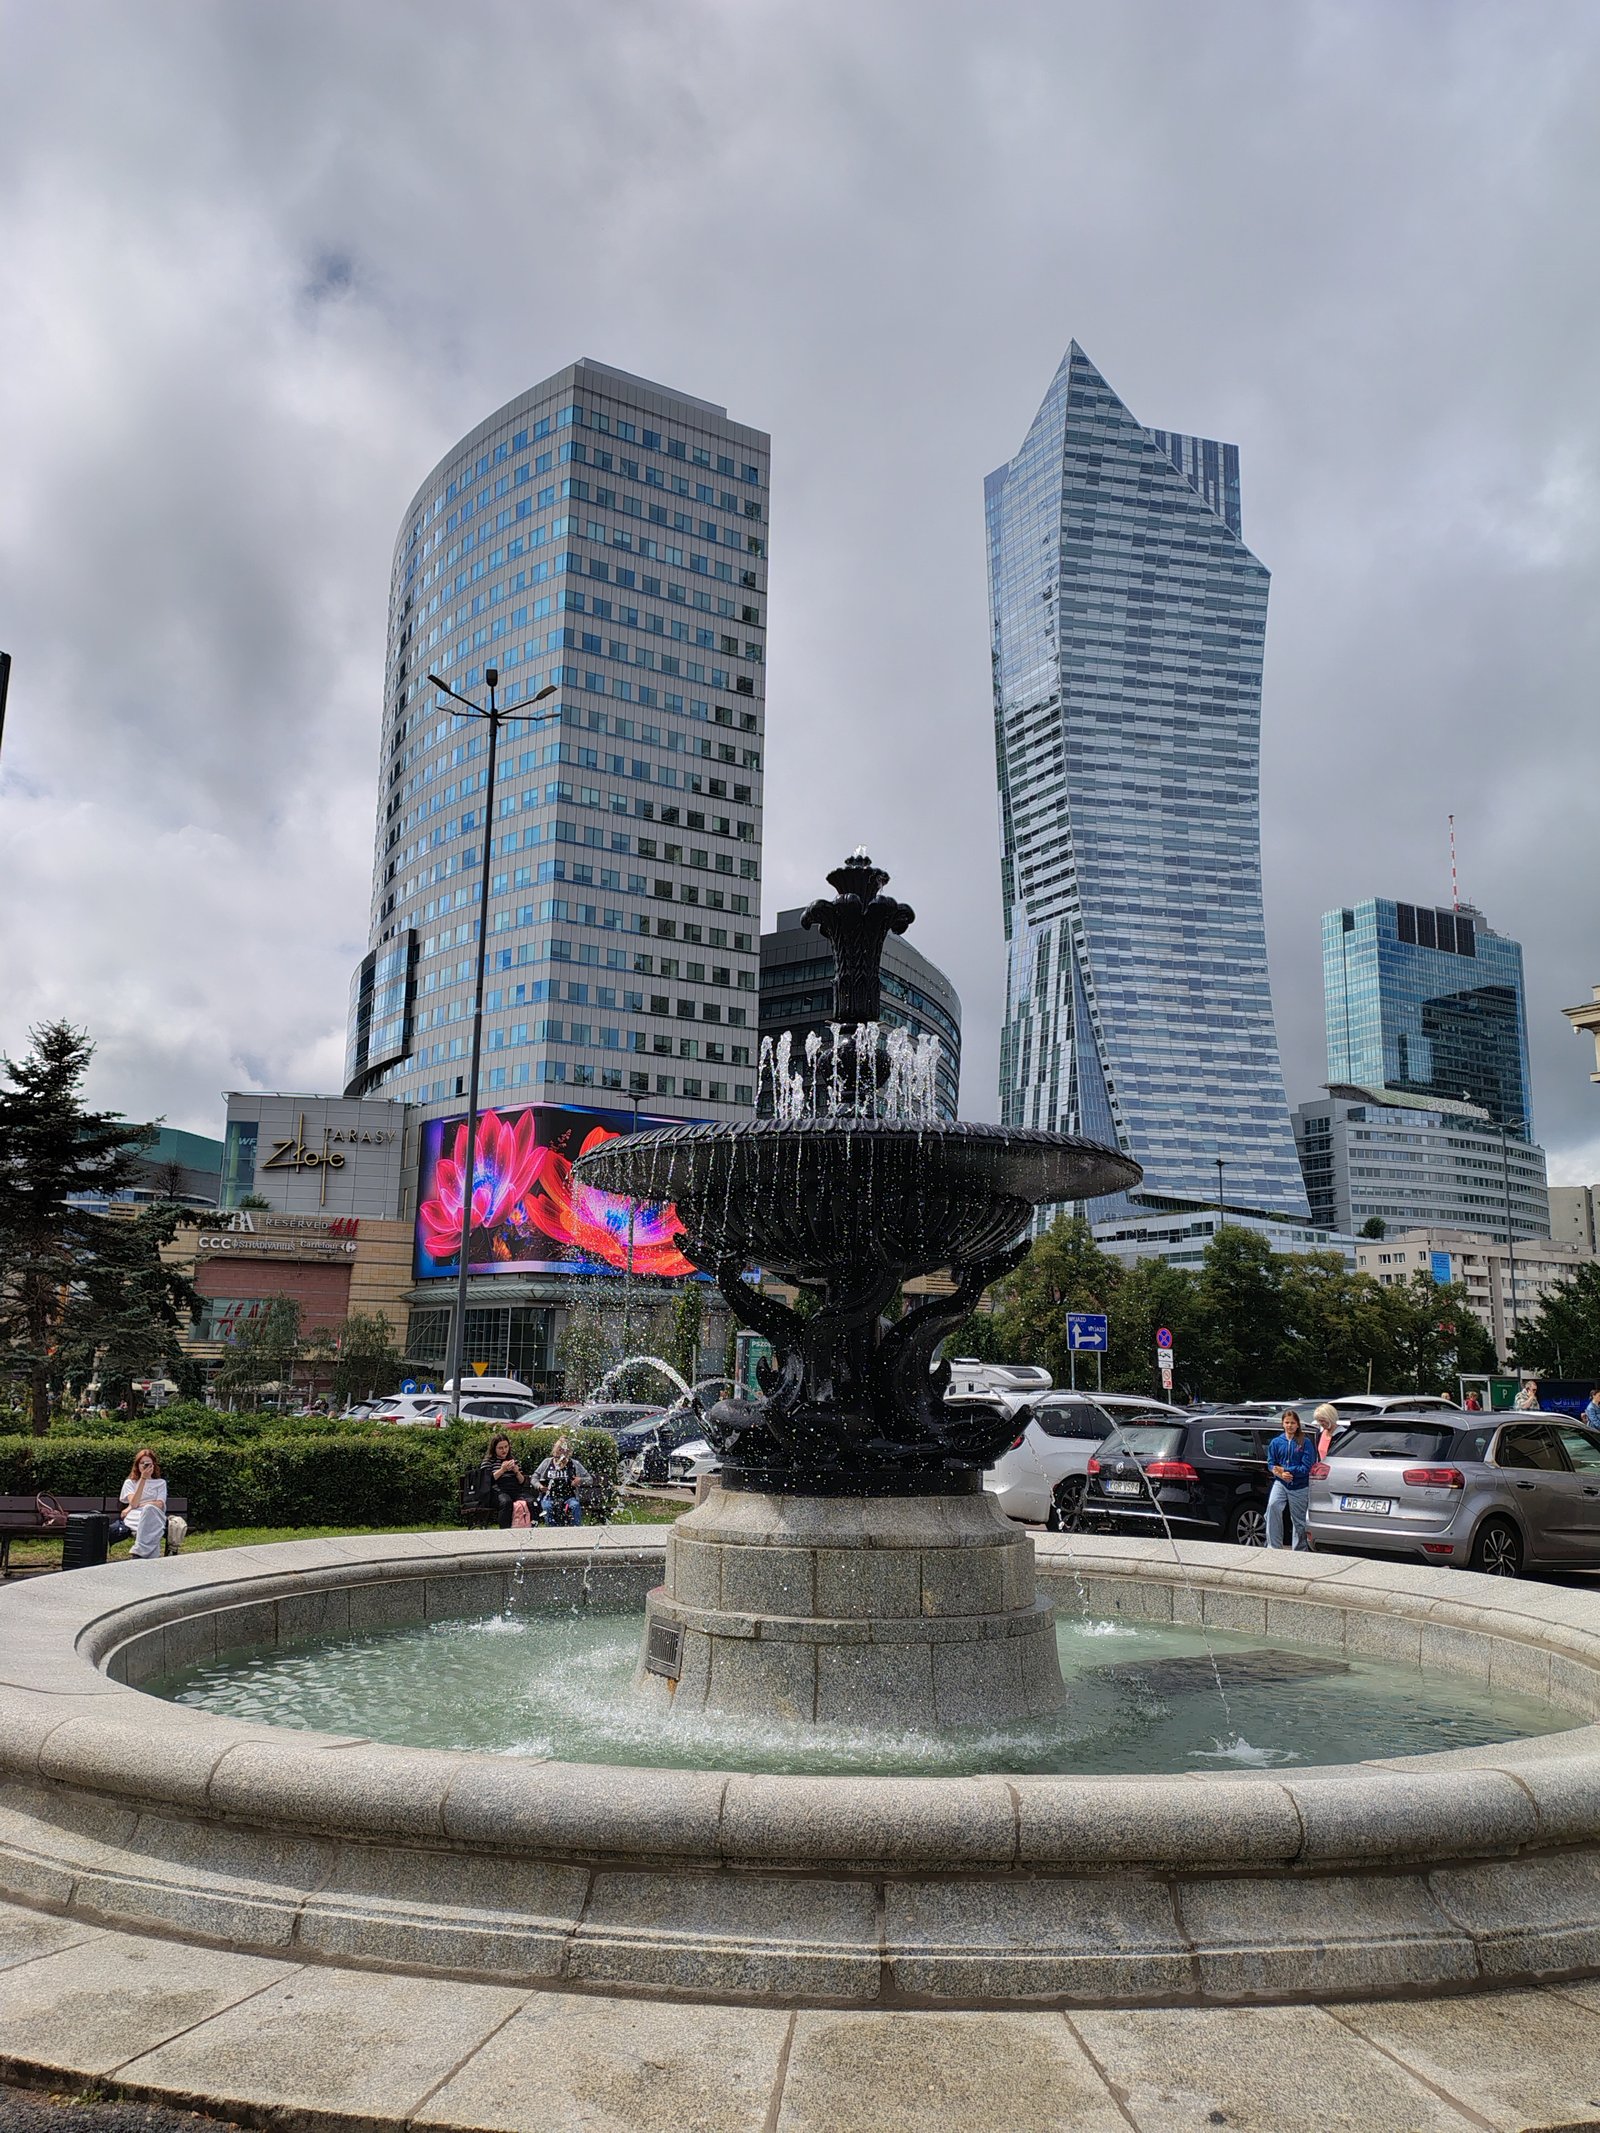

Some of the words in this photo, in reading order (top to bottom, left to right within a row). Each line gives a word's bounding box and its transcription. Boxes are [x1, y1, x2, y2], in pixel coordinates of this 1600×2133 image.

[323, 1127, 397, 1144] TARASY
[265, 1216, 329, 1230] RESERVED
[198, 1236, 232, 1249] CCC
[239, 1240, 296, 1251] STRADIVARIUS
[300, 1240, 339, 1250] Carrefour
[1502, 1388, 1508, 1399] P
[1346, 1498, 1358, 1509] WB
[1359, 1499, 1388, 1512] 704EA
